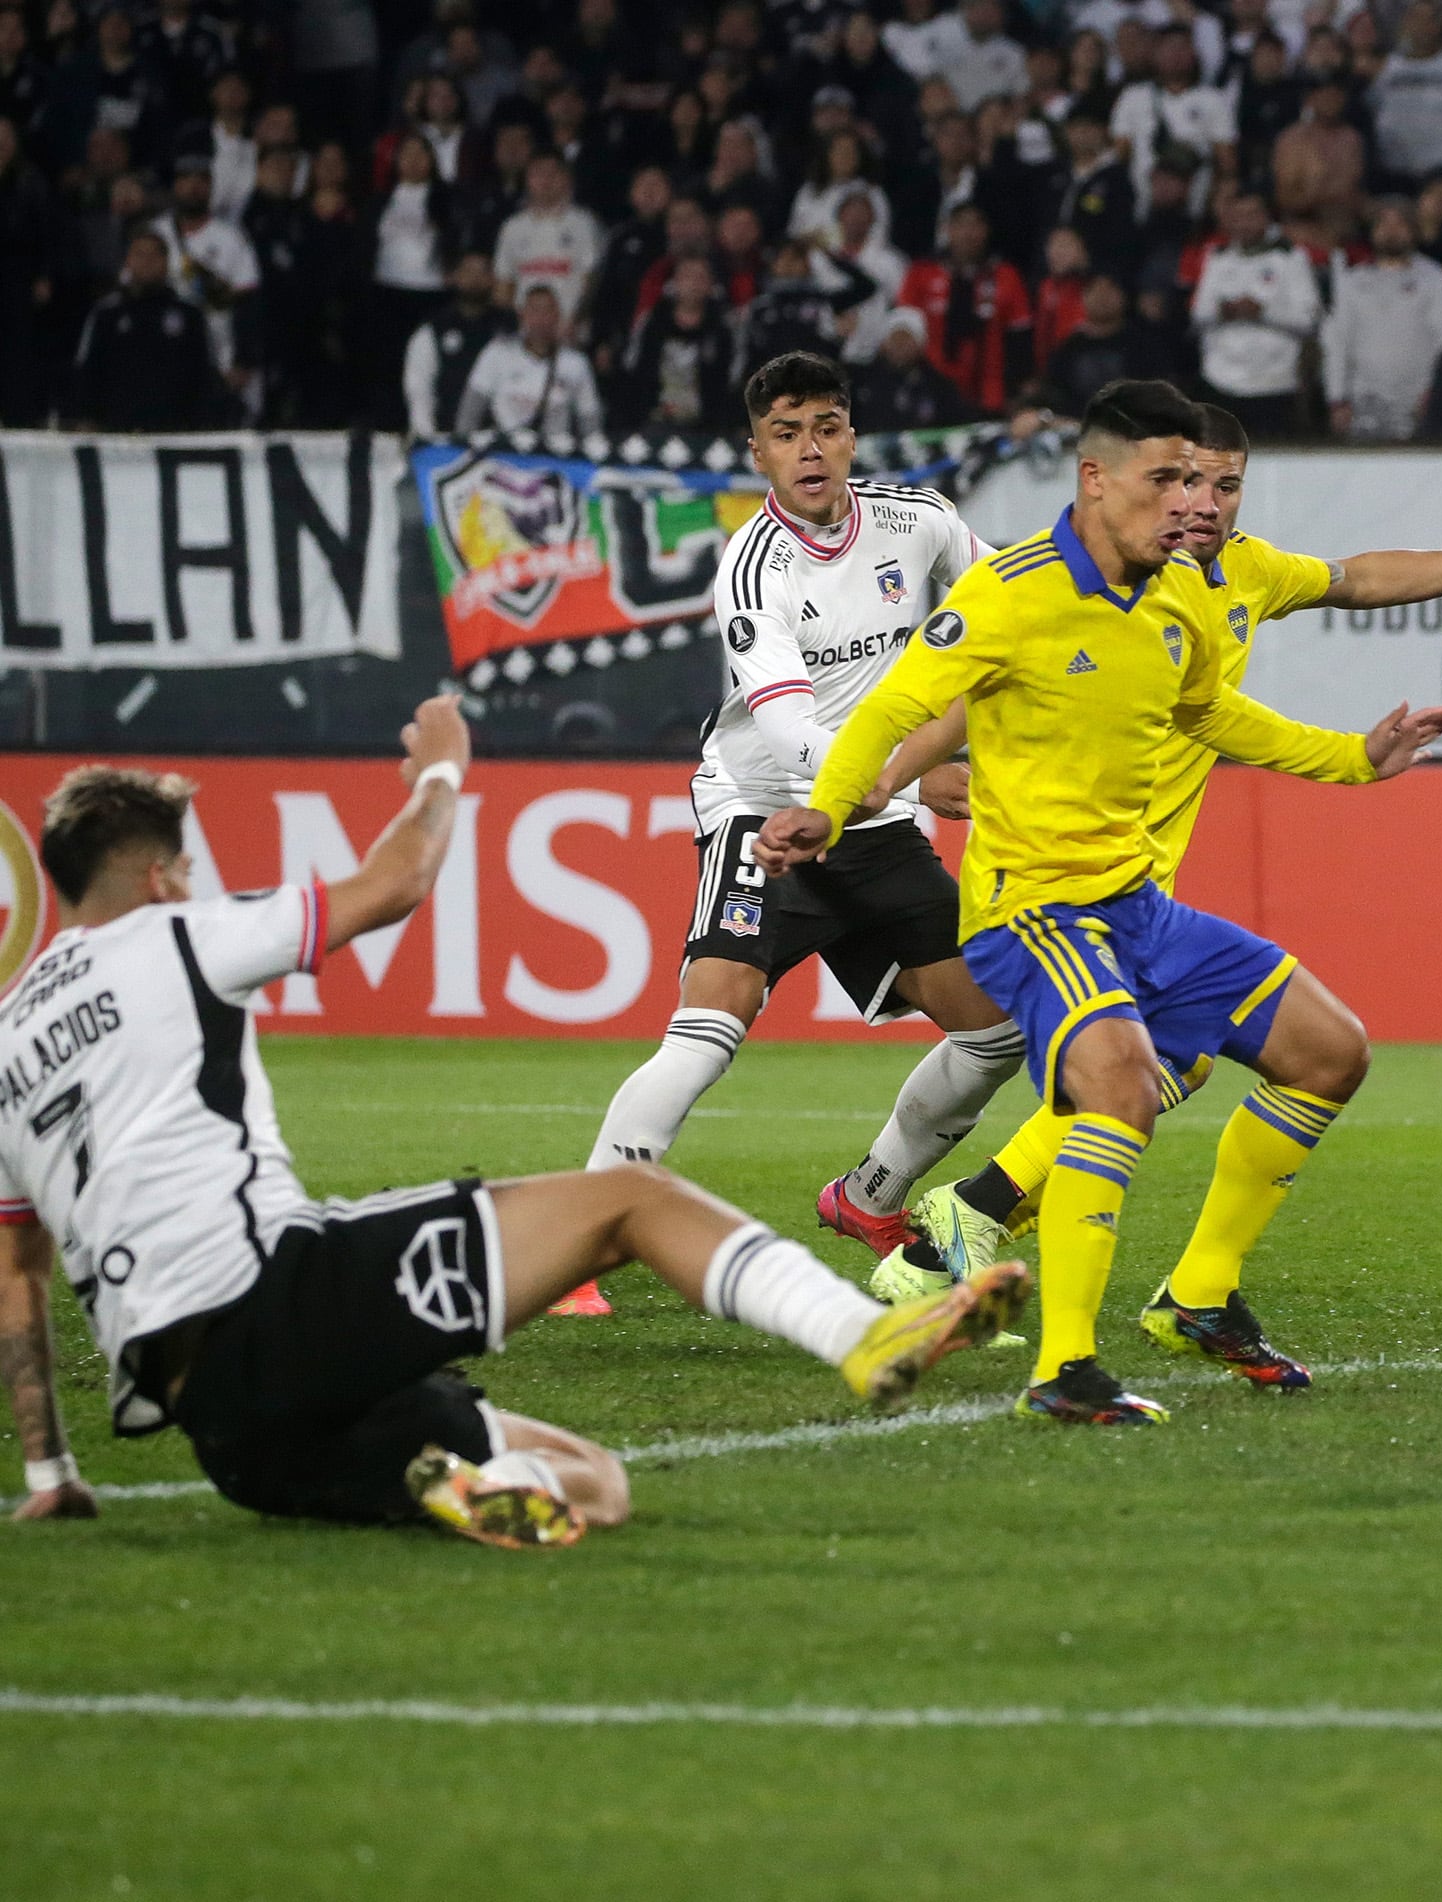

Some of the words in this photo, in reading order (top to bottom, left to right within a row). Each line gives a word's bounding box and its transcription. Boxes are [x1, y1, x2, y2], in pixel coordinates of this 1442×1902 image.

[872, 505, 918, 521] Pilsen
[875, 520, 889, 530] del
[890, 520, 916, 535] Sur
[1230, 615, 1248, 630] CABJ
[30, 1082, 91, 1198] 7
